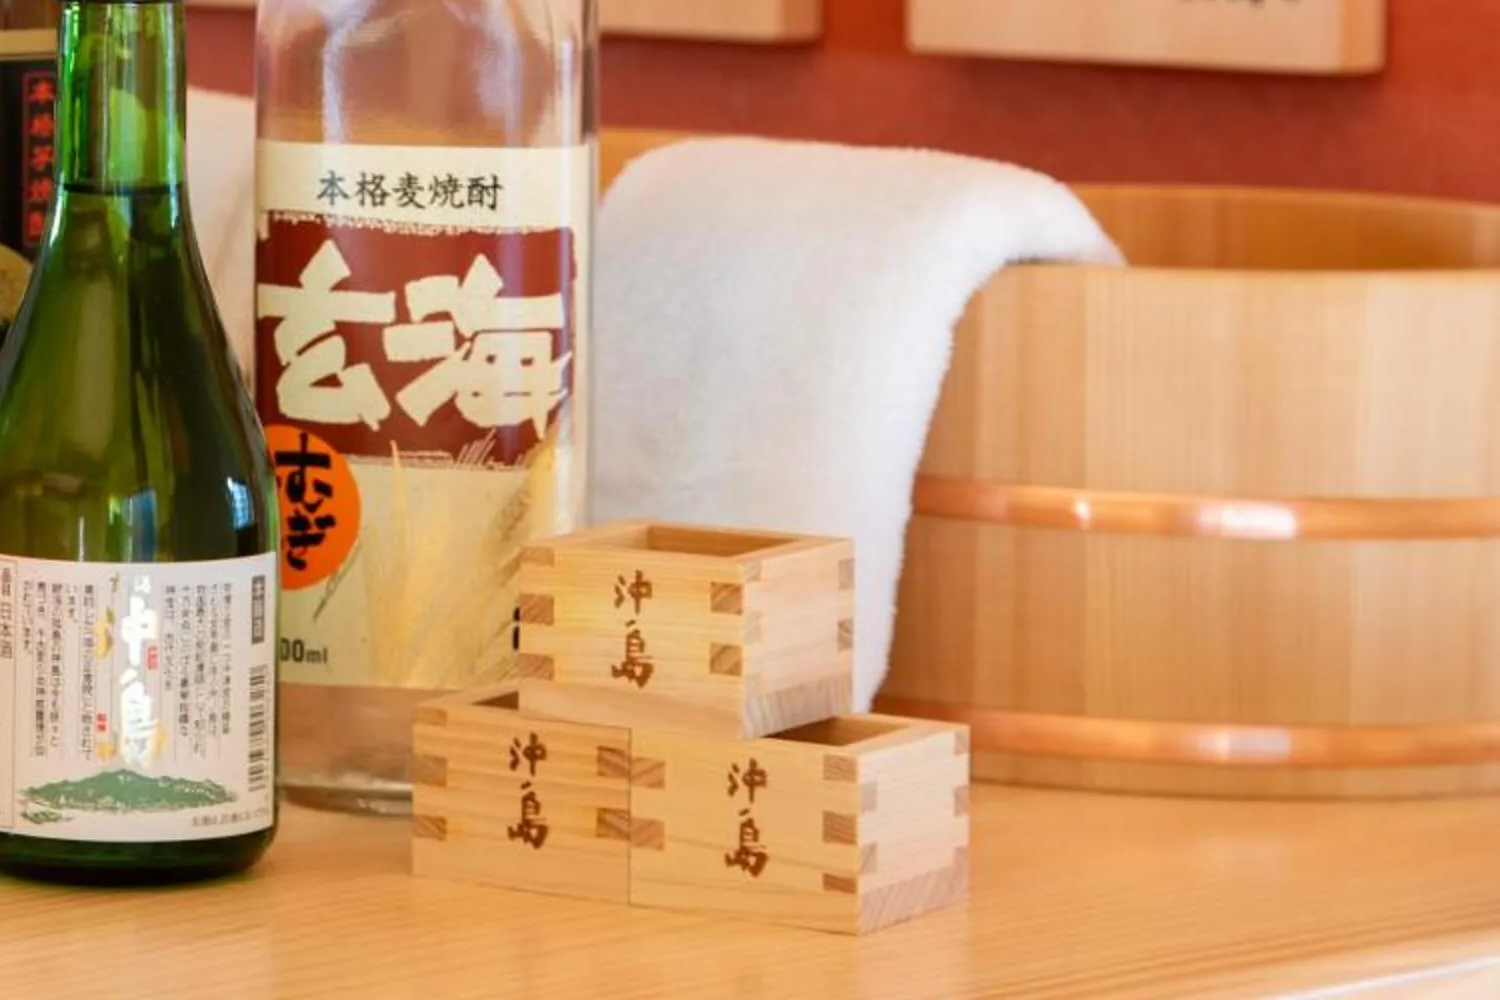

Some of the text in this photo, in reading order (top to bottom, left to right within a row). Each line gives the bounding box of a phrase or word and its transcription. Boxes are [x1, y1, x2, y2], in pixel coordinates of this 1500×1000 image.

[316, 169, 504, 211] 本格麦焼酎
[257, 238, 572, 440] 玄海
[279, 636, 328, 664] 00ml
[611, 569, 654, 688] 沖島
[507, 732, 549, 850] 沖島
[724, 757, 770, 877] 沖島
